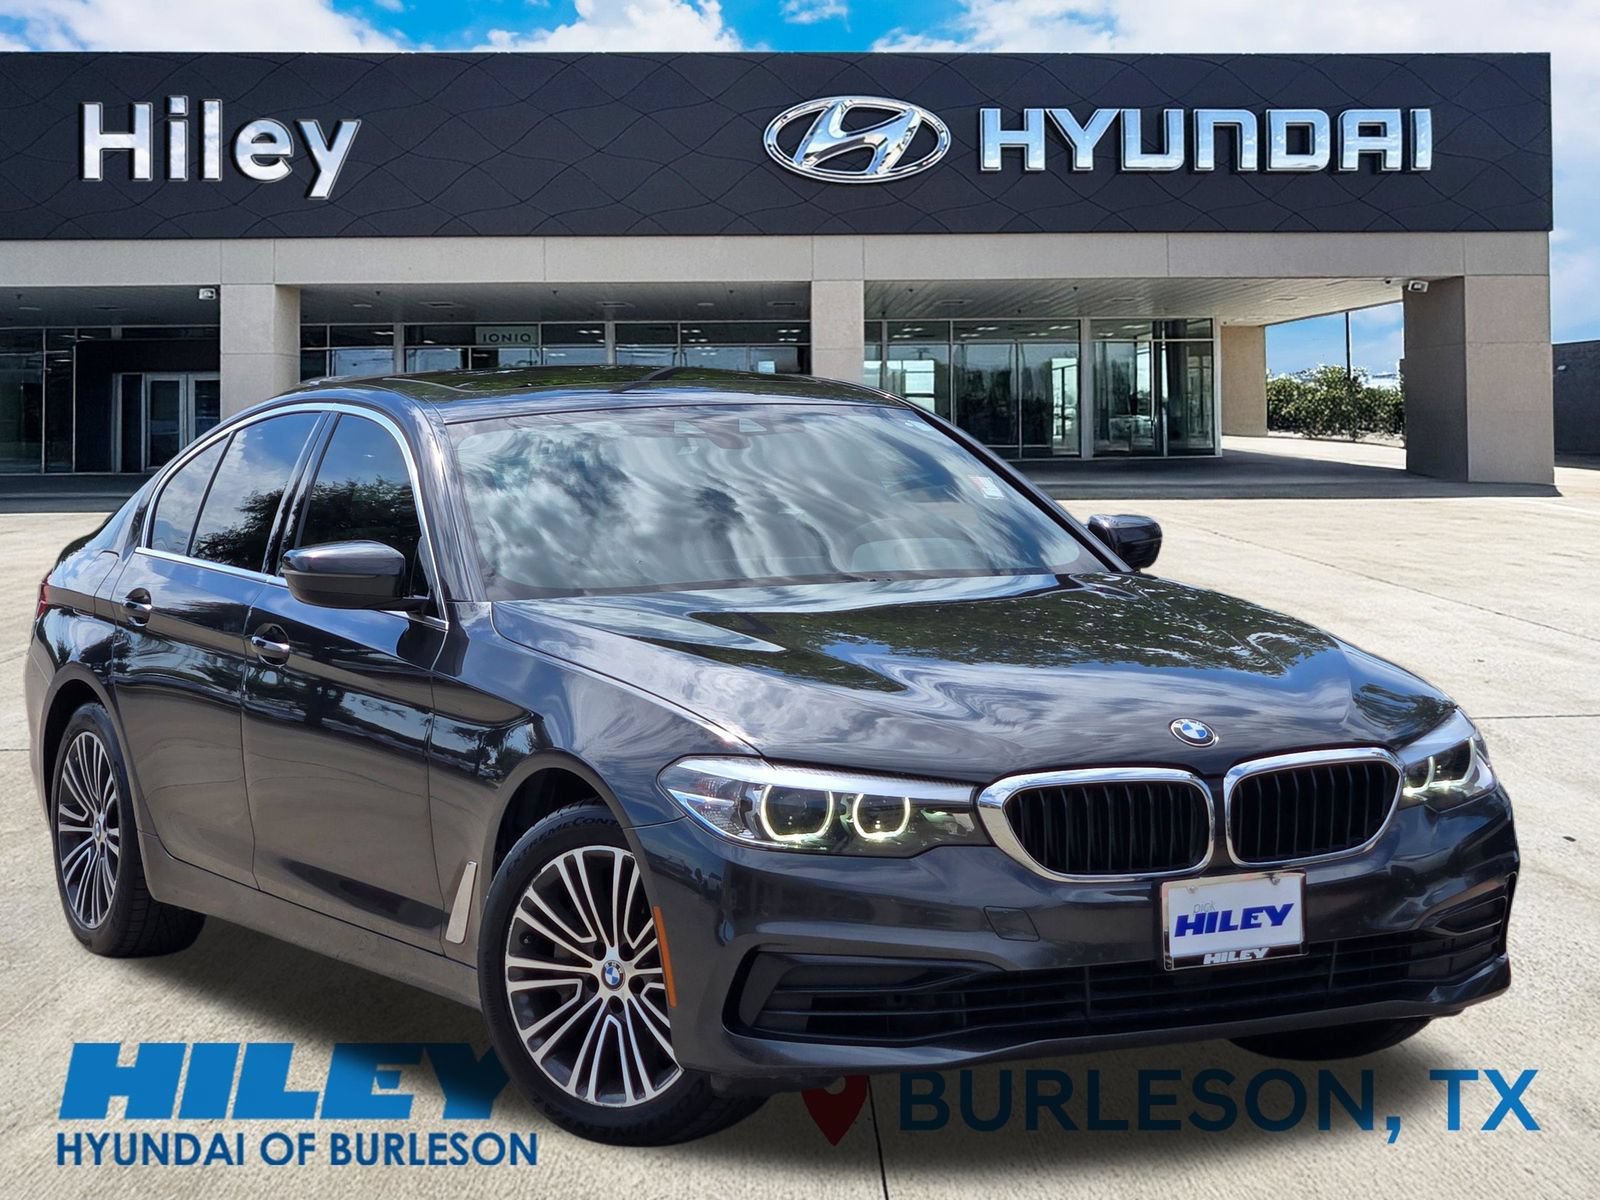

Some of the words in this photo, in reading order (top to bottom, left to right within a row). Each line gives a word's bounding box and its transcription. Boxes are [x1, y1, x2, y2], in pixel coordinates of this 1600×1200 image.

[79, 95, 361, 200] Hiley
[979, 108, 1433, 172] HYUNDAI
[483, 333, 532, 343] IONIQ
[1173, 902, 1294, 937] HILEY
[1203, 947, 1269, 965] HILEY
